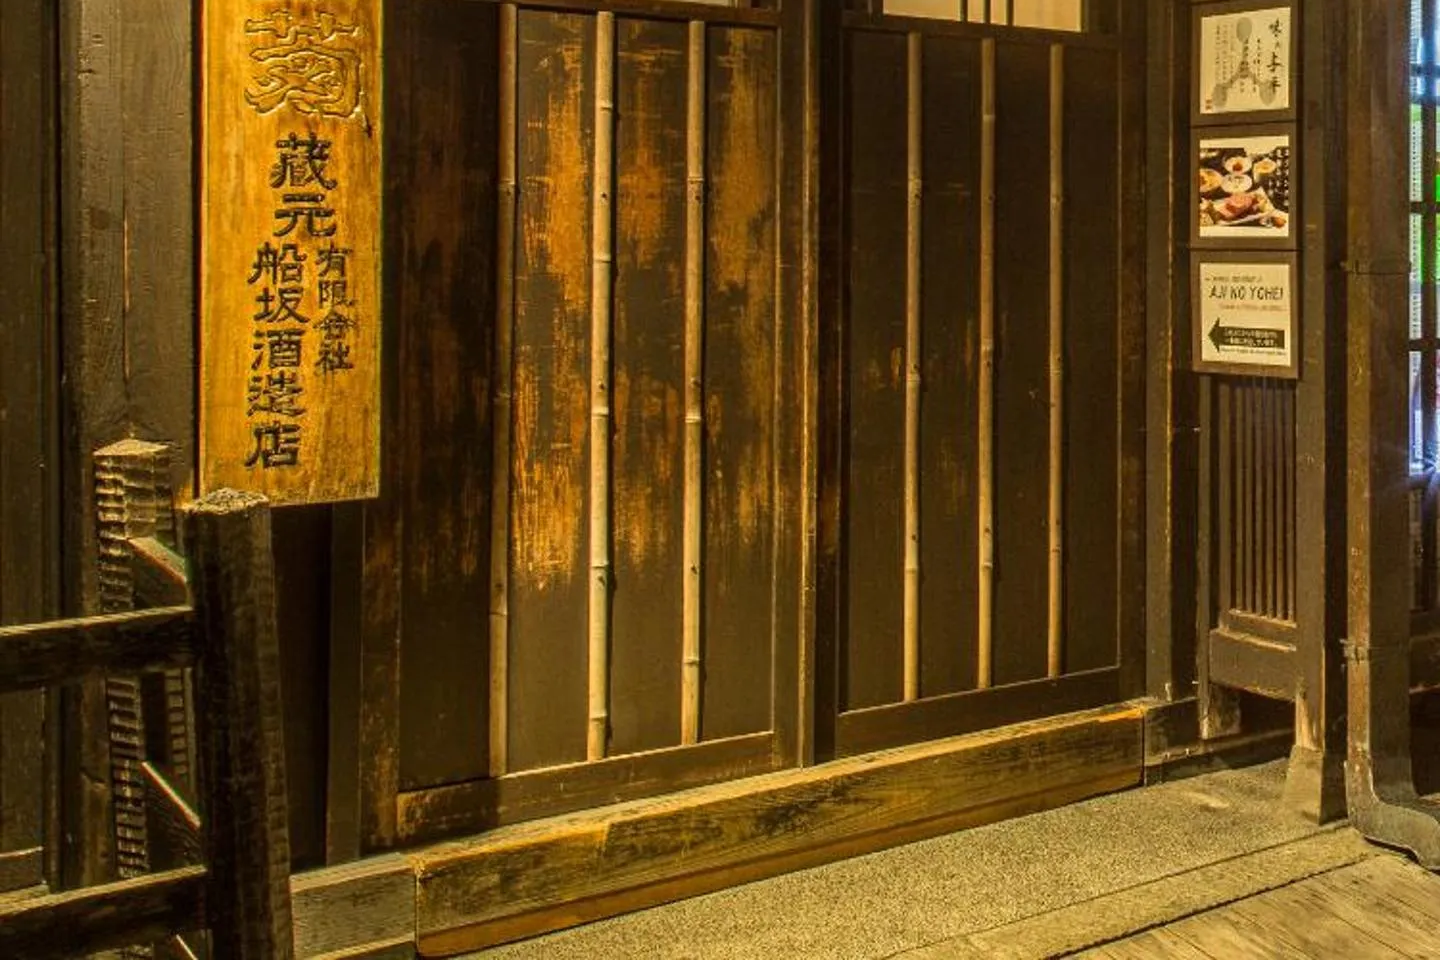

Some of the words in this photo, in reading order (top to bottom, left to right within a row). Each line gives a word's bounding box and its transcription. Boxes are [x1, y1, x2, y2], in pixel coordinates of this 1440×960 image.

[244, 242, 309, 468] 船坂酒造店
